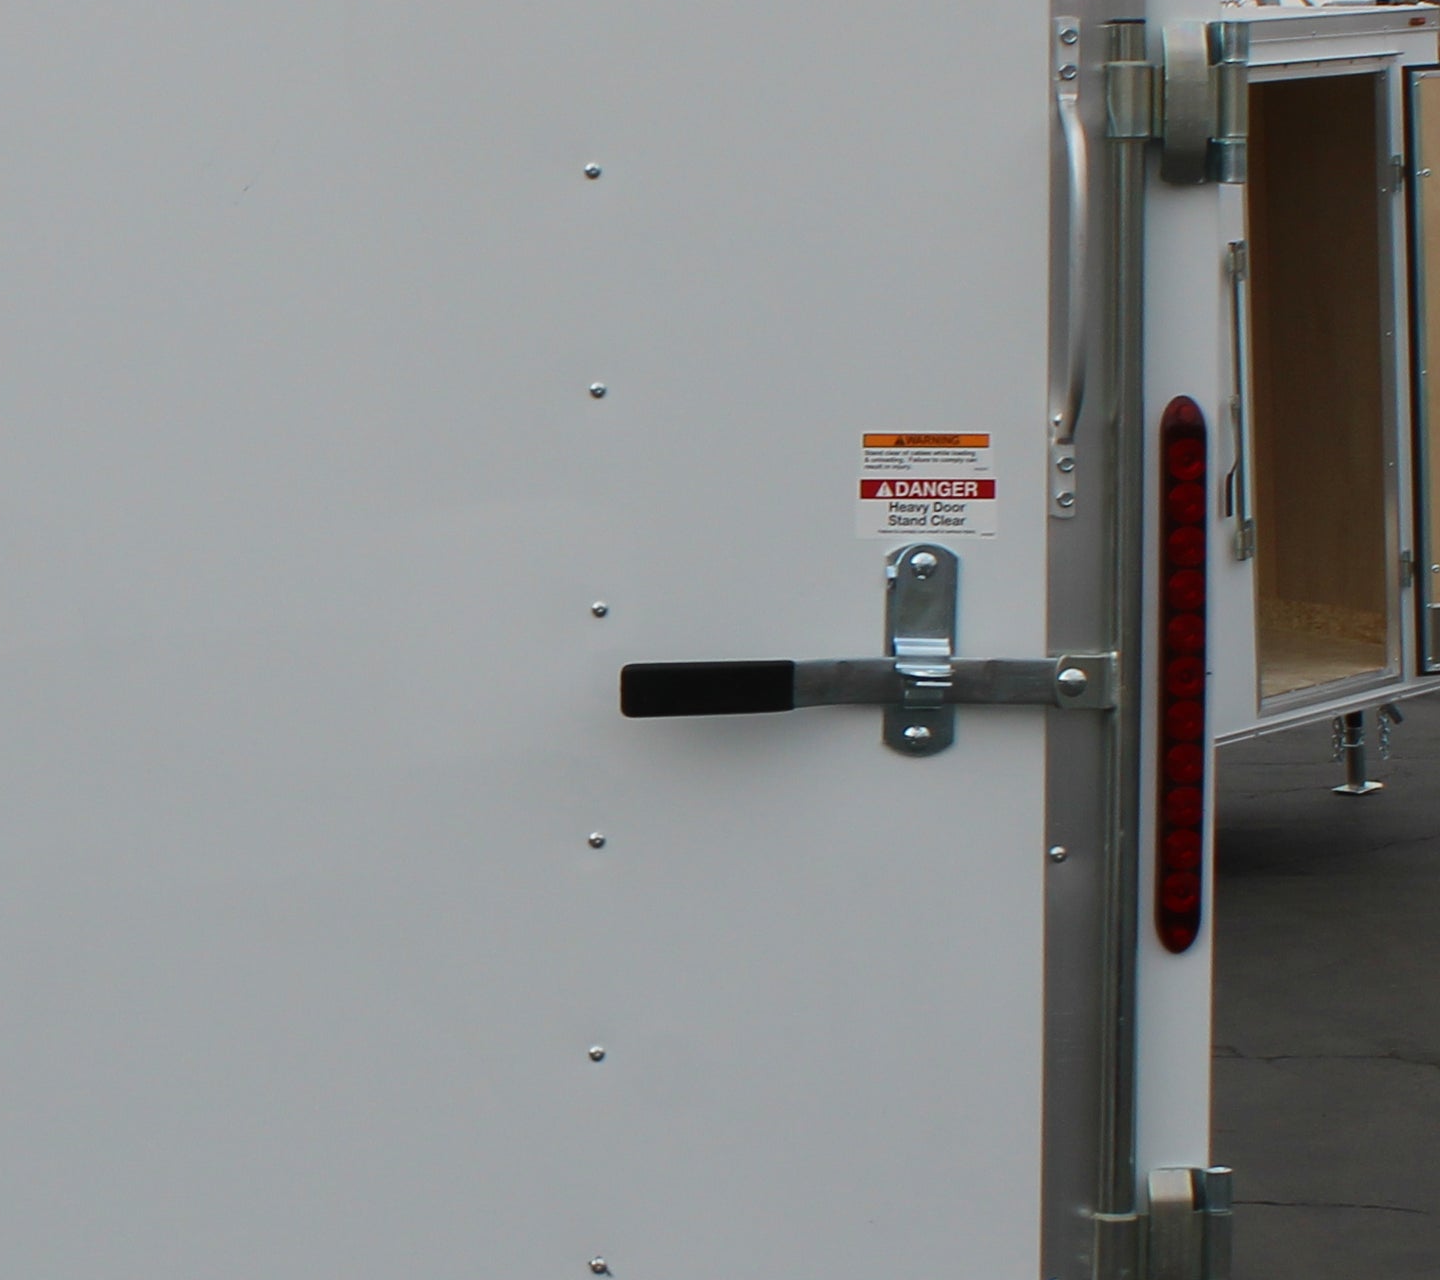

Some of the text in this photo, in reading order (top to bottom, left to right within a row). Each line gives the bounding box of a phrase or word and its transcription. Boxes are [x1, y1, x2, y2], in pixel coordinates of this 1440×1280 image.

[905, 434, 961, 446] WARNING
[895, 482, 978, 497] DANGER
[888, 502, 966, 514] Heavy Door
[888, 515, 966, 526] Stand Clear
